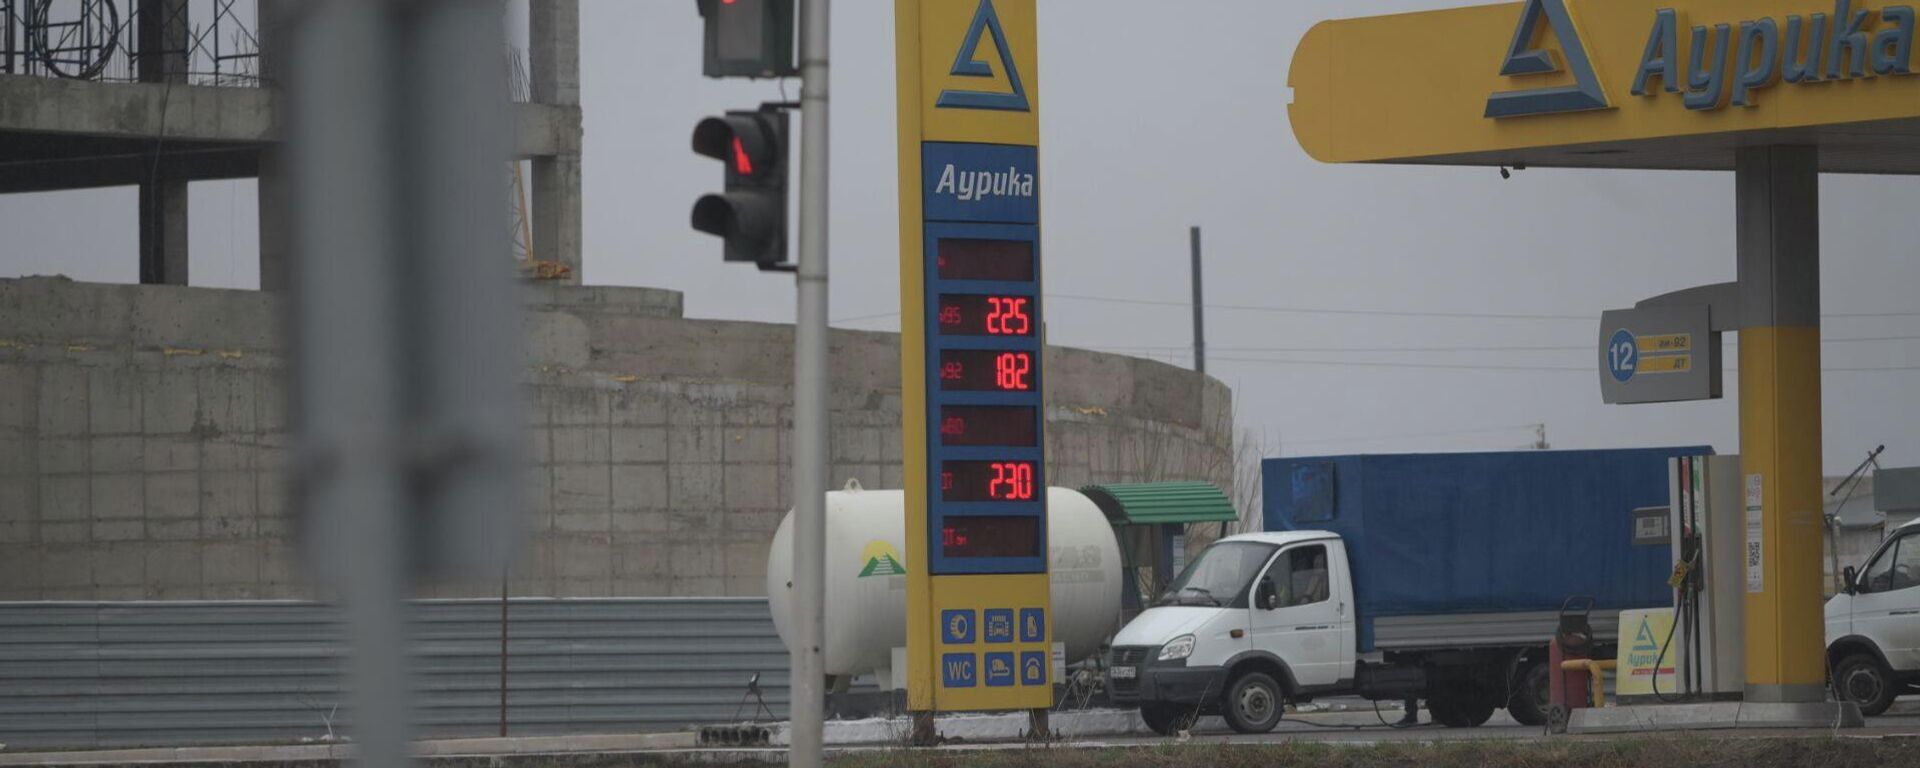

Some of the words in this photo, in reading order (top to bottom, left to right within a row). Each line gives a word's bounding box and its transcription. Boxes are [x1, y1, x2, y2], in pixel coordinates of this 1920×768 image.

[936, 163, 1034, 201] Аурика
[987, 297, 1029, 334] 225
[996, 353, 1029, 390] 182
[1610, 341, 1634, 371] 12
[990, 463, 1033, 499] 230
[948, 661, 972, 681] WC
